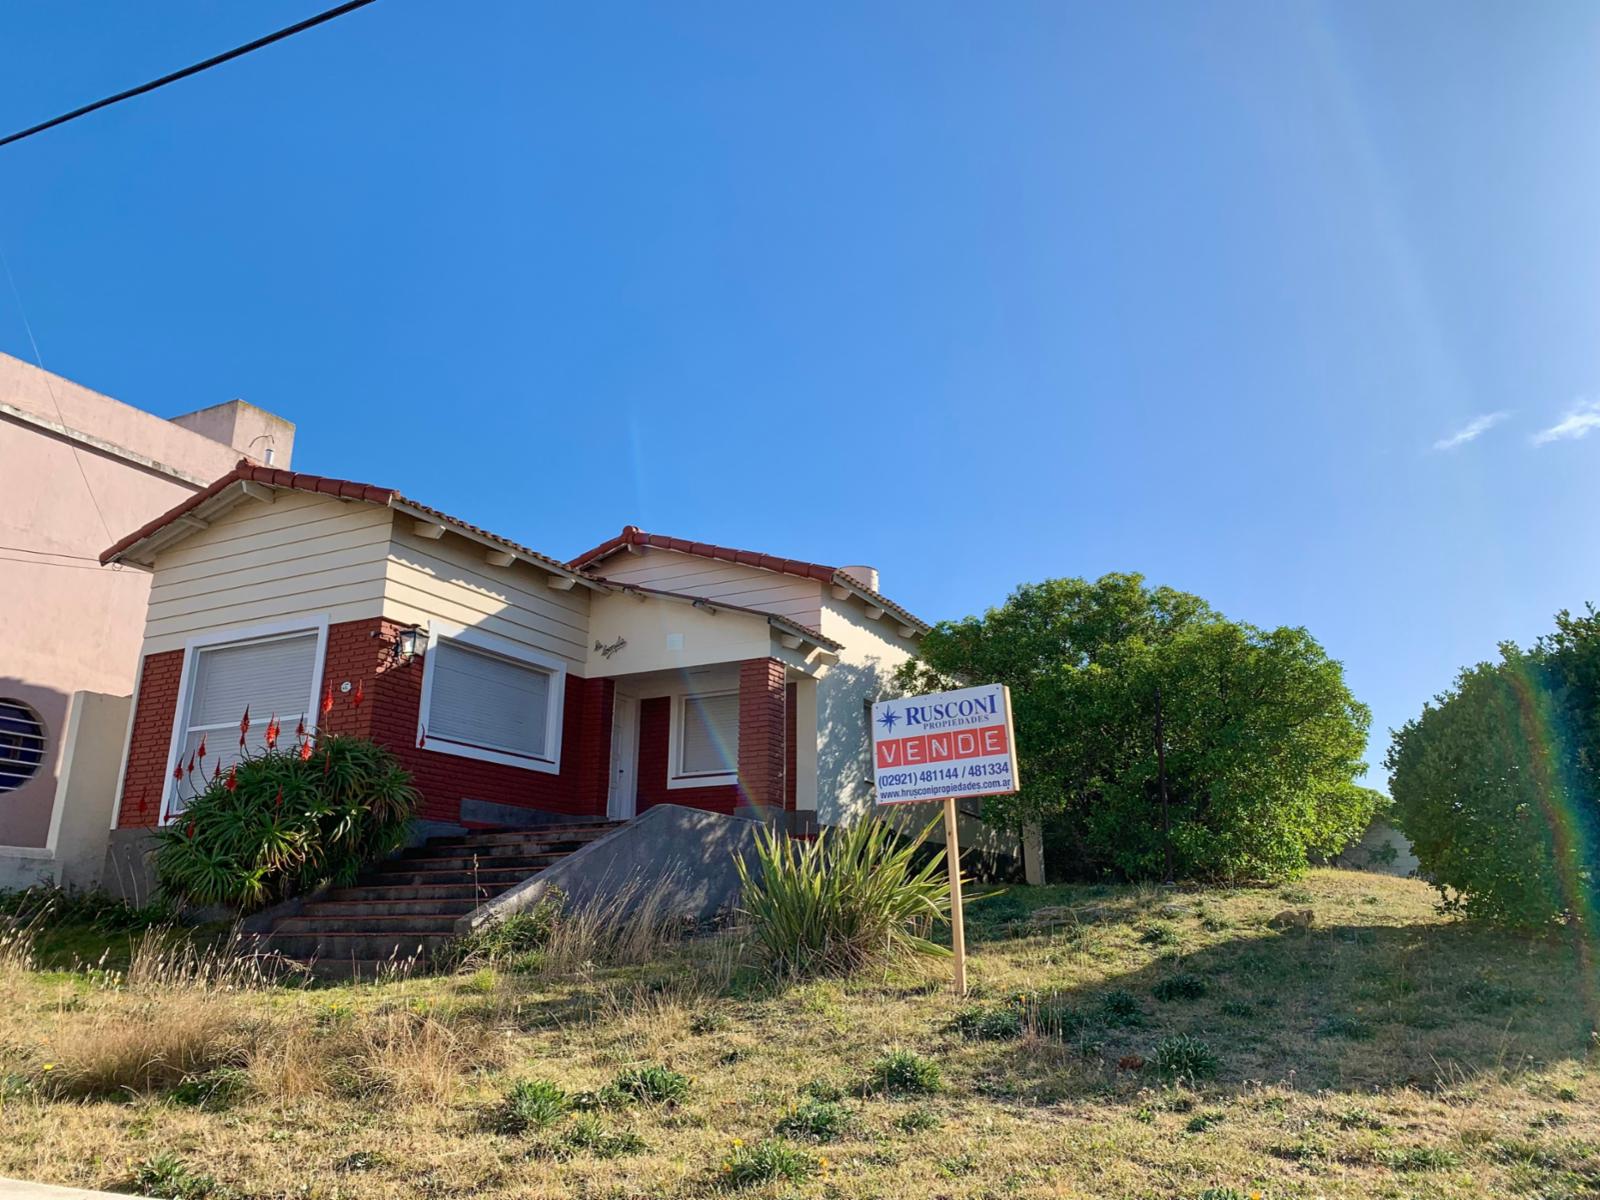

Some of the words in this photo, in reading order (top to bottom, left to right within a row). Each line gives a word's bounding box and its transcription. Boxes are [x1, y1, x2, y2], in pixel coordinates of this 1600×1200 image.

[905, 694, 997, 726] RUSCONI
[923, 714, 990, 730] PROPIEDADES
[881, 731, 1001, 763] VENDE
[878, 772, 918, 789] (02921)
[920, 767, 959, 783] 481144
[968, 762, 1009, 777] 481334
[880, 778, 1011, 799] www.hrusconipropiedades.com.ar
